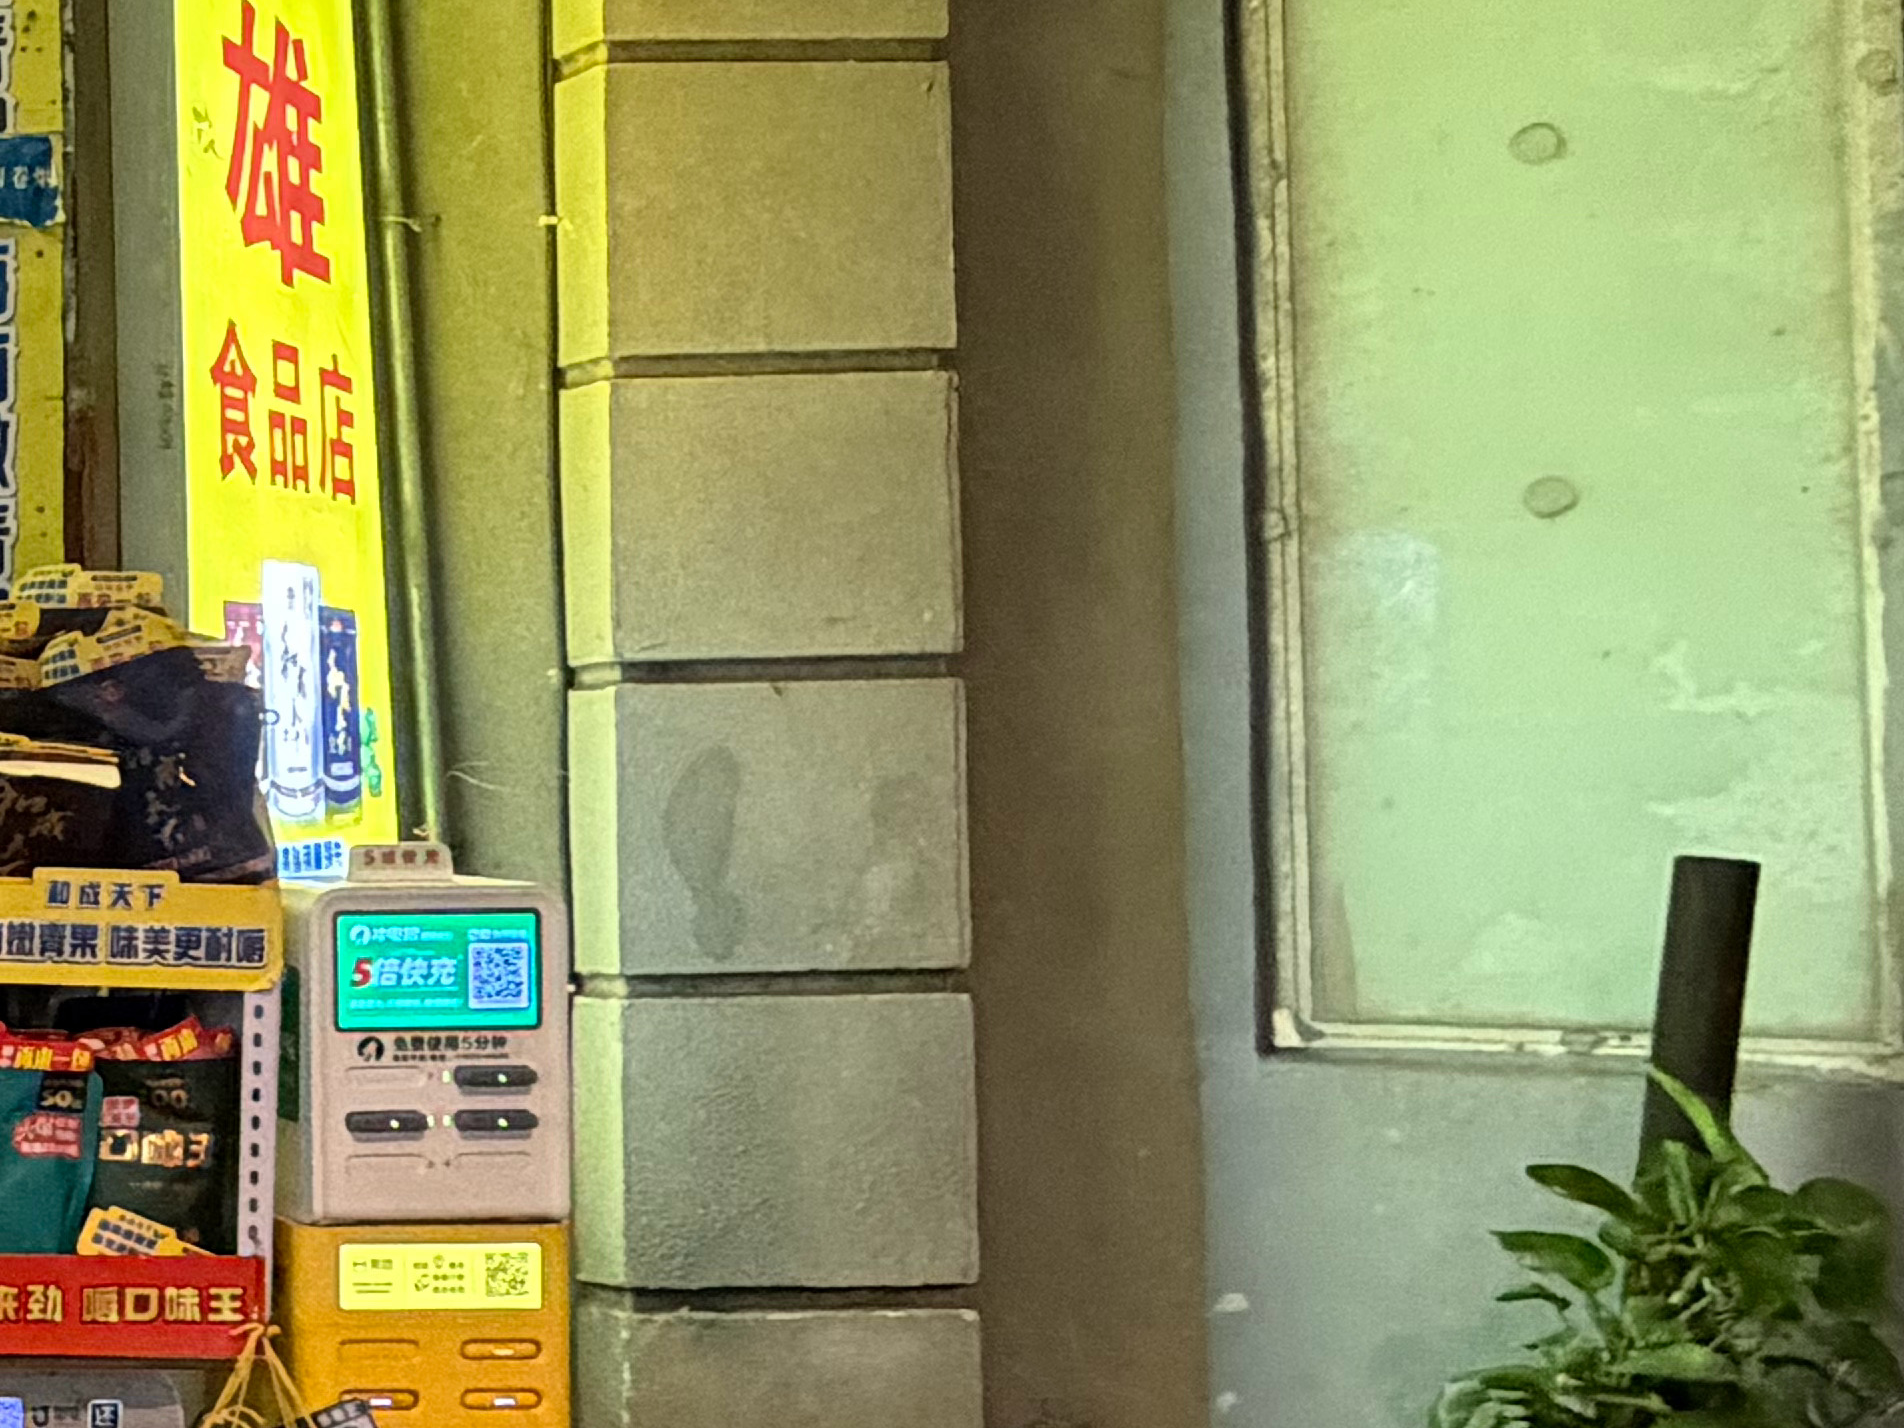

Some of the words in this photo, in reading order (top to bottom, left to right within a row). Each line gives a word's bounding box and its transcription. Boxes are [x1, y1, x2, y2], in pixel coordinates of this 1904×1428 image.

[210, 318, 356, 505] 食品店
[47, 879, 166, 910] 和成天下
[349, 955, 458, 989] 5倍快充
[81, 1285, 246, 1324] 嚼口味王
